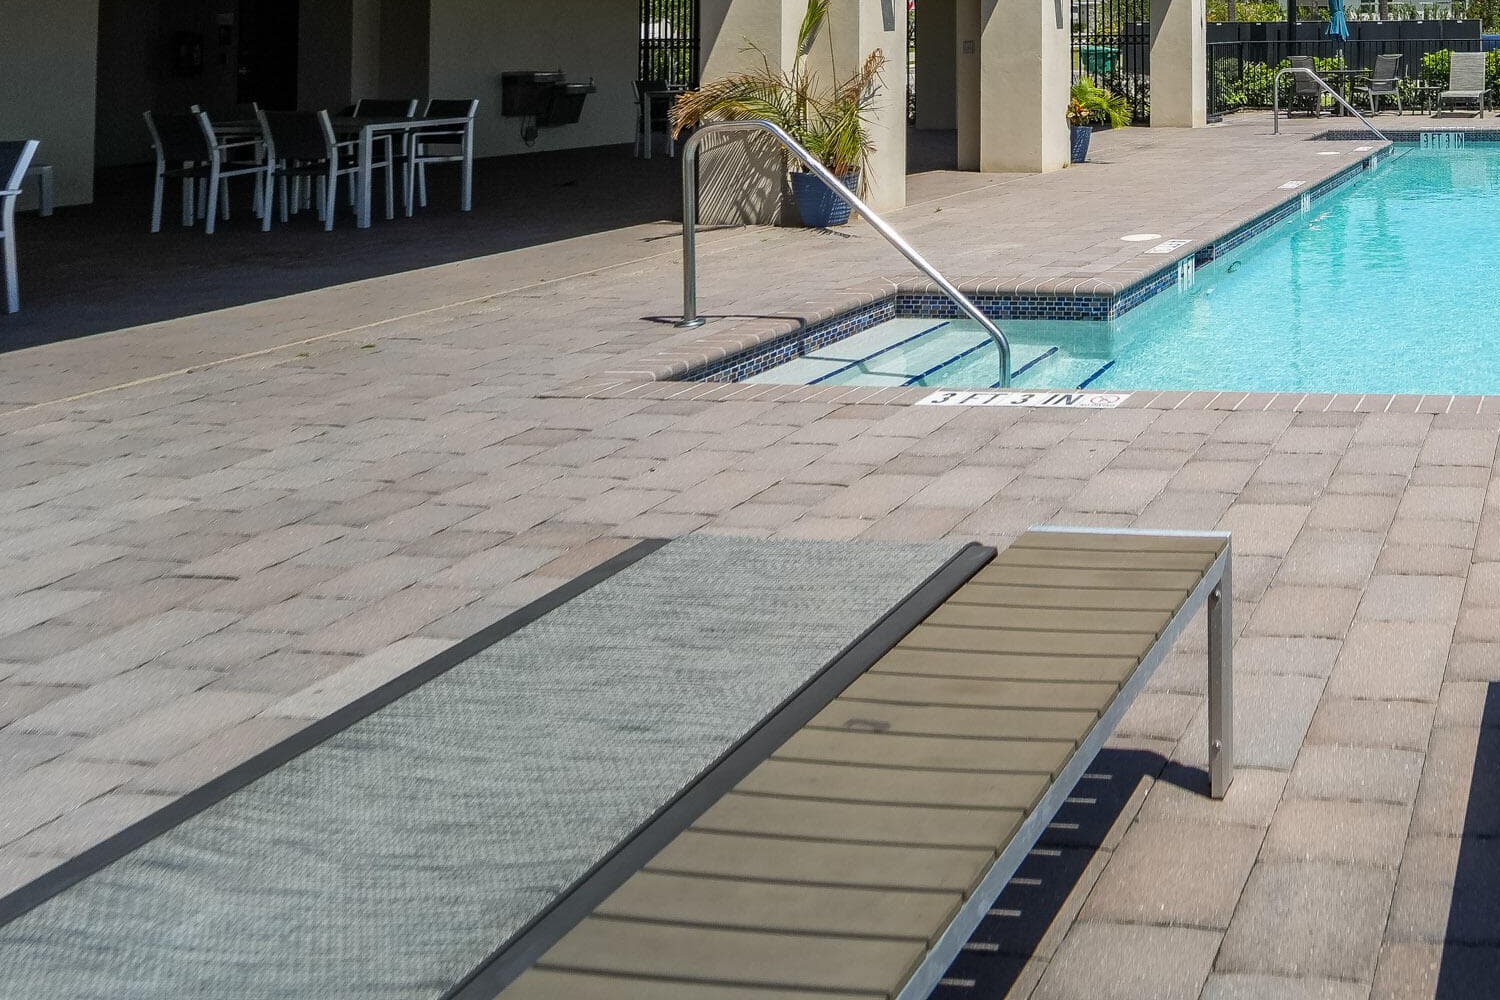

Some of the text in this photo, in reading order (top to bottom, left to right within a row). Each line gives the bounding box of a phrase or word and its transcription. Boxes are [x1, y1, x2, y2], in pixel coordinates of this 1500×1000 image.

[931, 392, 957, 404] 3
[960, 393, 1008, 404] FT
[1011, 394, 1035, 404] 3
[1042, 394, 1085, 405] IN
